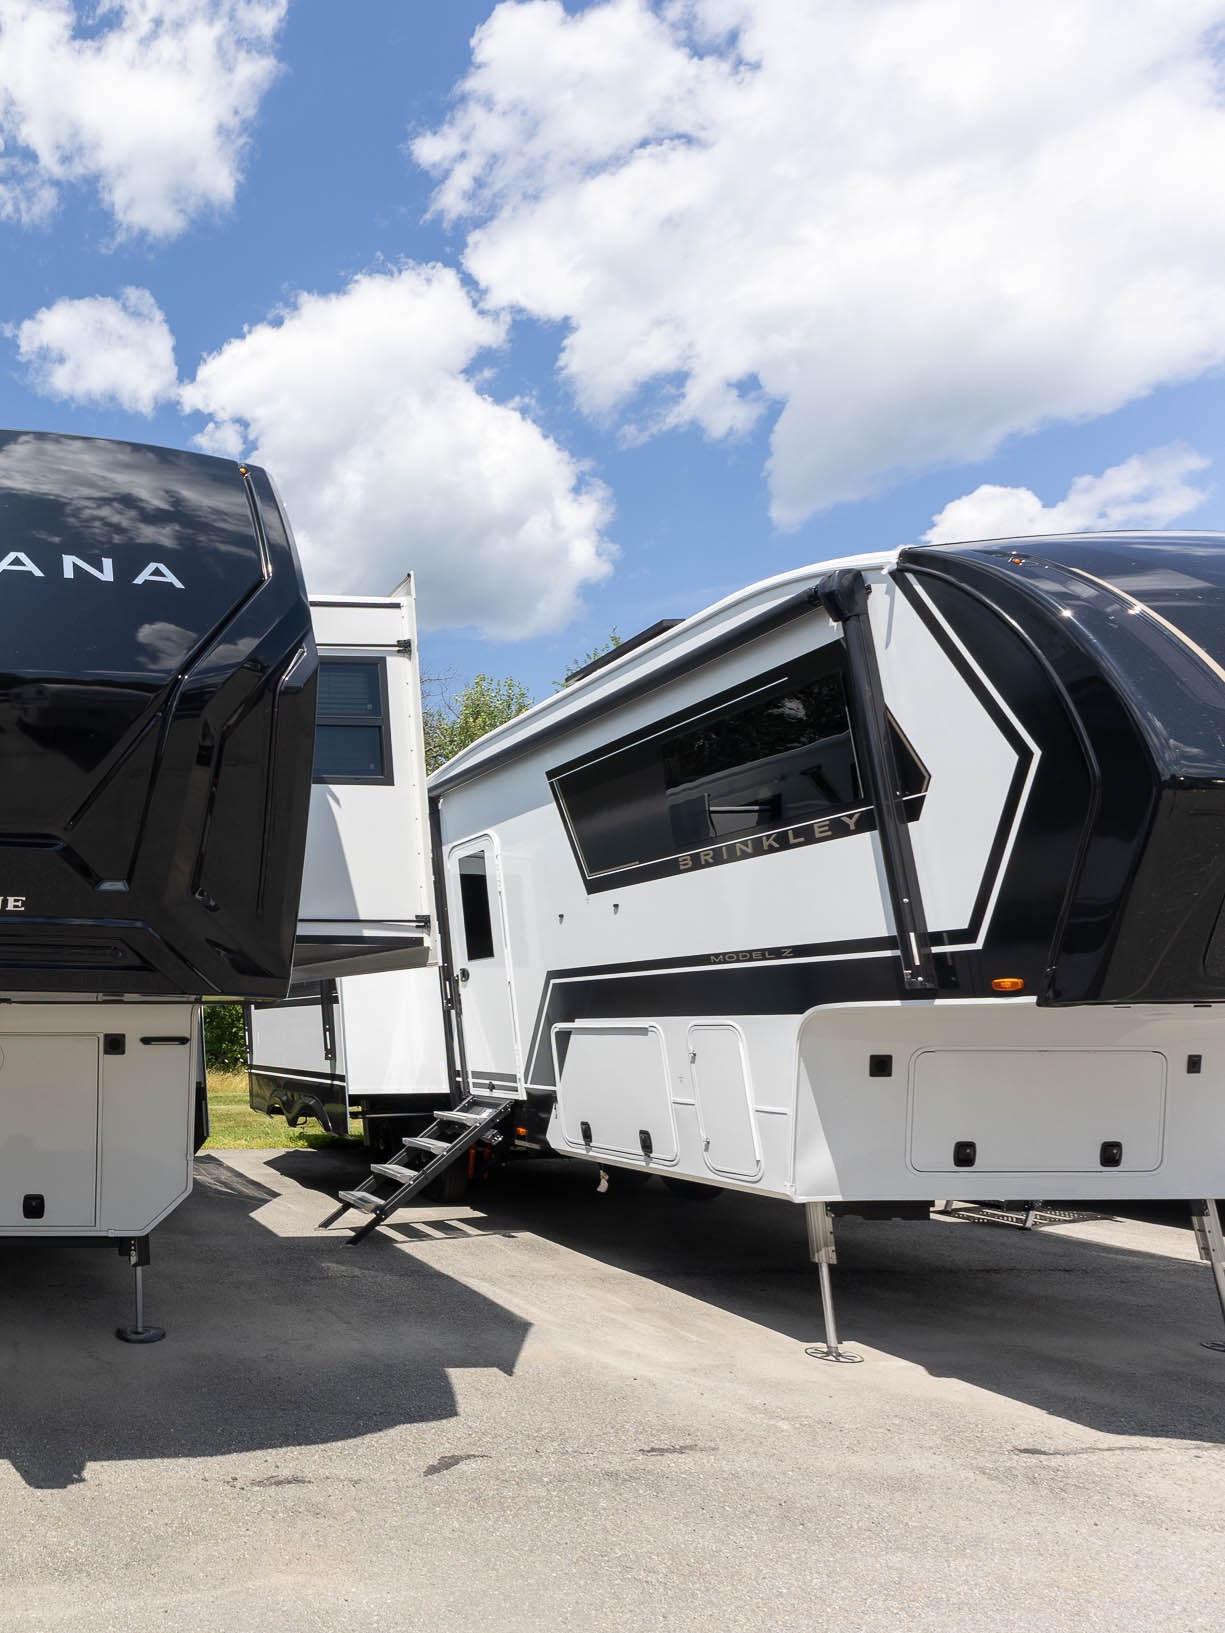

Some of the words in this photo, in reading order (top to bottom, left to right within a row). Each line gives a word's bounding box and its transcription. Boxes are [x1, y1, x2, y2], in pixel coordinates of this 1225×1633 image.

[678, 812, 862, 870] BRINKLEY
[710, 950, 776, 963] MODEL
[781, 948, 794, 958] Z
